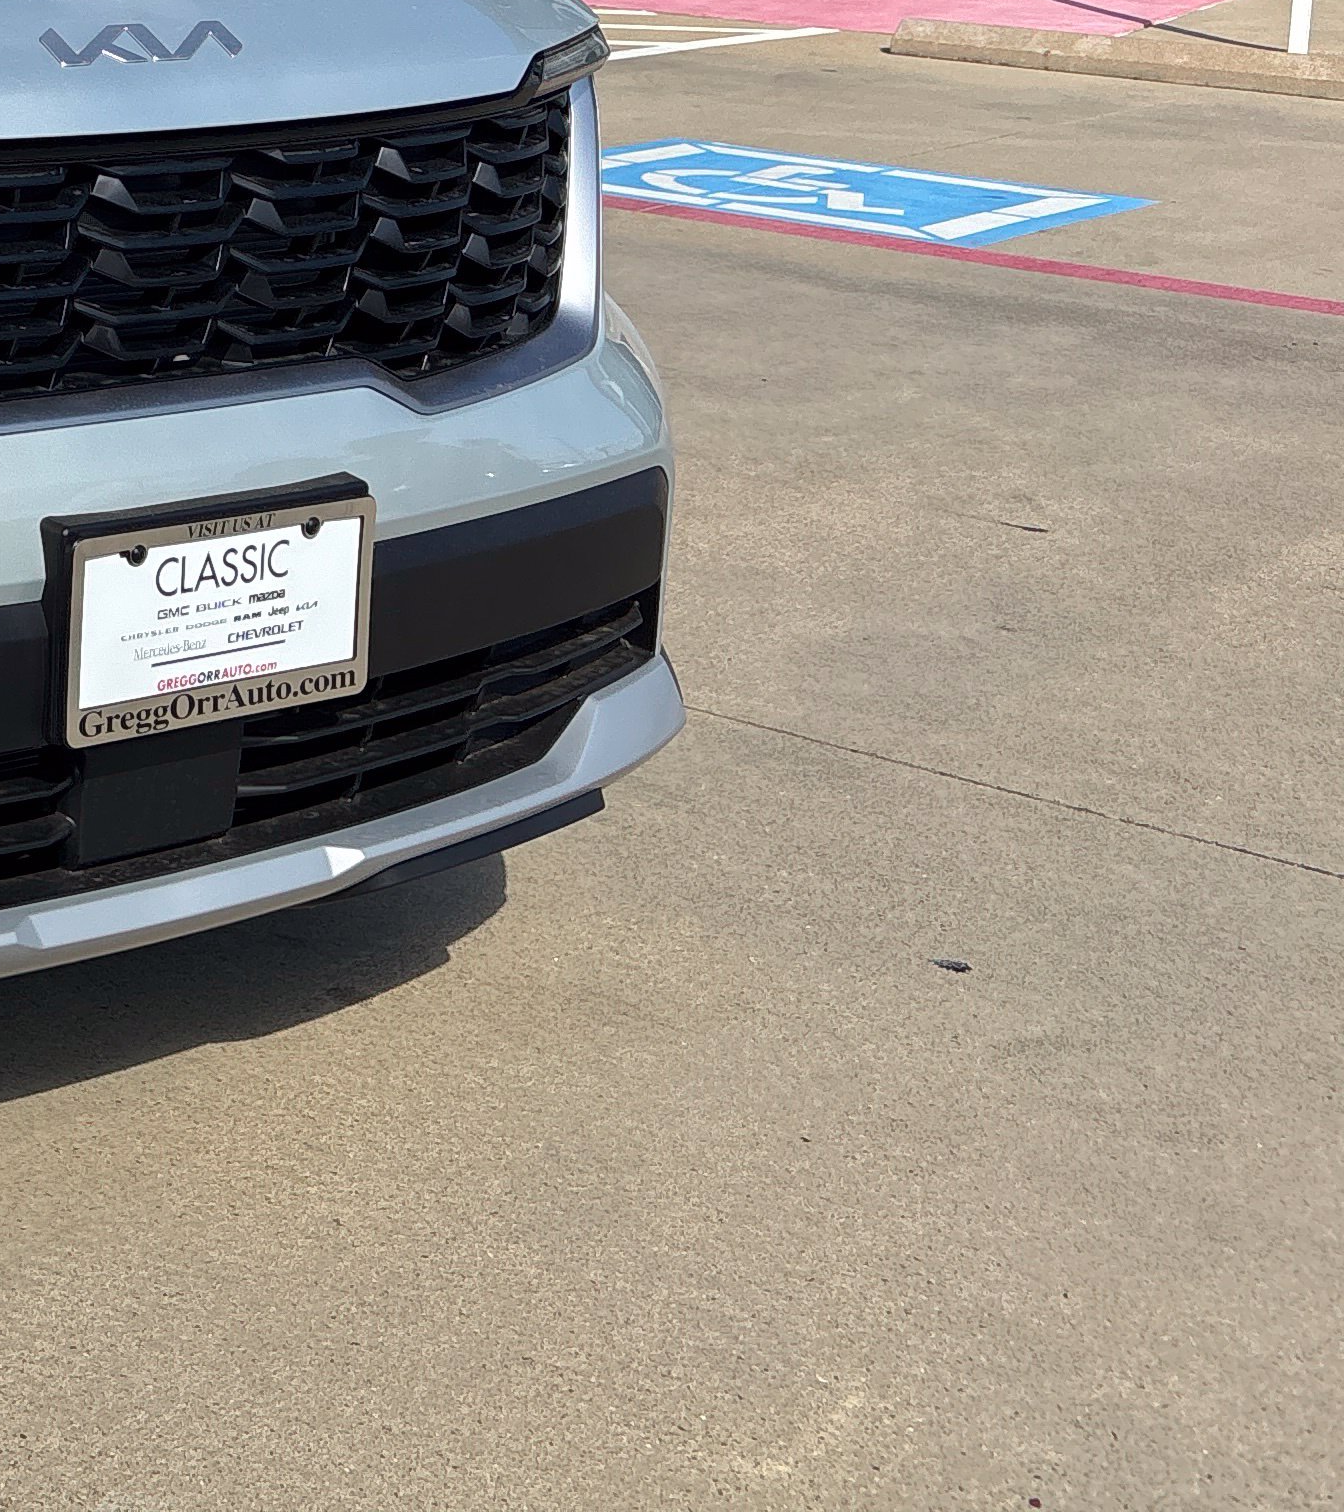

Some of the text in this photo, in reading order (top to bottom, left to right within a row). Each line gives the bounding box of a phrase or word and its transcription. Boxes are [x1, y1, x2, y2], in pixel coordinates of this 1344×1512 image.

[38, 20, 243, 67] KIA
[187, 512, 276, 539] VISIT US AT
[156, 539, 290, 597] CLASSIC
[120, 626, 179, 642] CHRYSLER
[185, 618, 228, 630] DODGE
[233, 611, 262, 622] RAM
[268, 606, 290, 618] Jeep
[157, 605, 190, 620] GMC
[196, 597, 242, 613] BUICK
[133, 620, 304, 661] Mercedes-Benz CHEVROLET
[157, 661, 277, 691] GREGGORRAUTO.com
[78, 669, 356, 738] GreggOrrAuto.com
